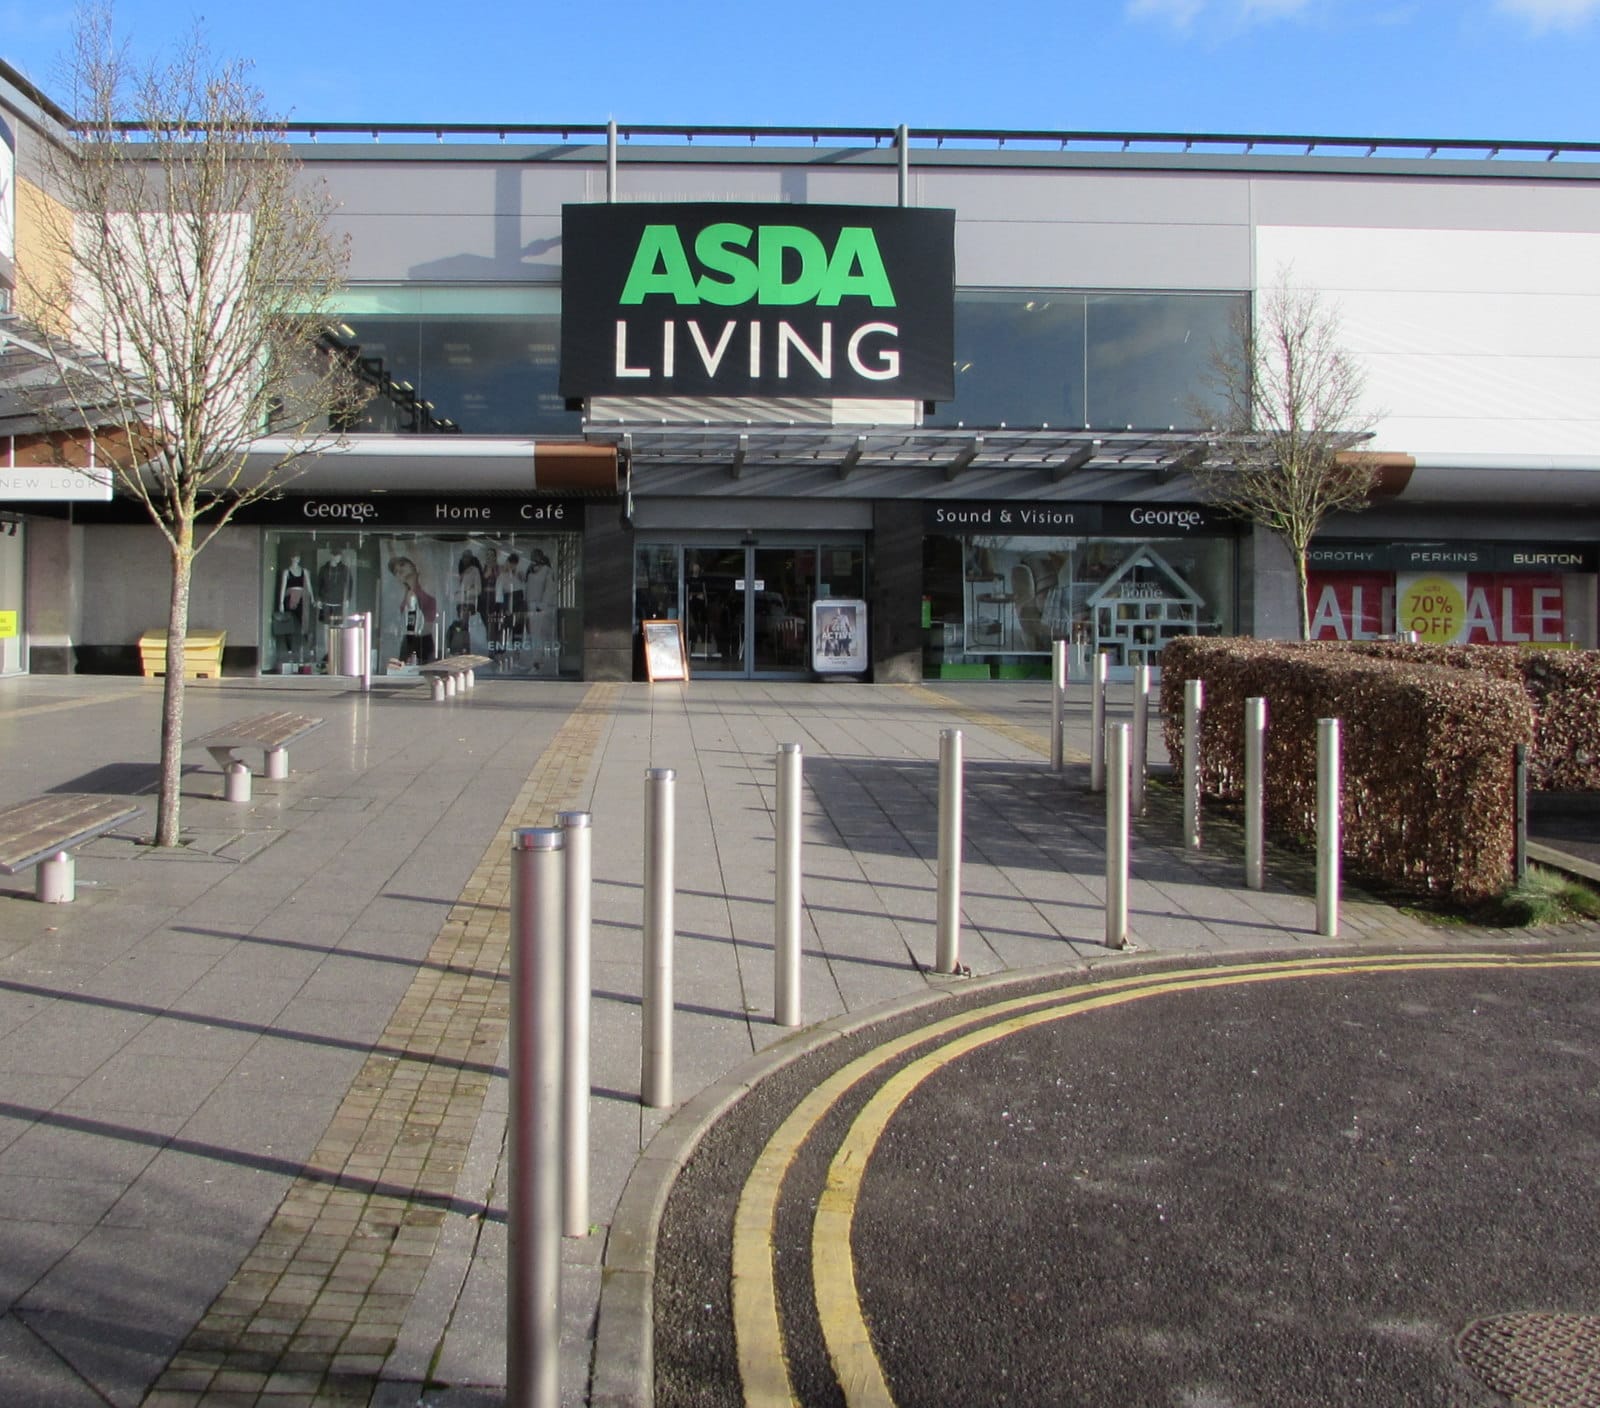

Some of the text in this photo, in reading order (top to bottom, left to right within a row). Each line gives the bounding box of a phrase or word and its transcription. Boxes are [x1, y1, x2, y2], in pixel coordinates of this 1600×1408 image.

[618, 222, 897, 307] ASDA
[614, 319, 901, 381] LIVING
[0, 478, 98, 489] NEW LOOK
[303, 500, 379, 523] George.
[435, 503, 564, 519] Home Café
[936, 508, 1074, 524] Sound & Vision
[1130, 507, 1205, 531] George.
[1410, 552, 1479, 562] PERKINS
[1513, 553, 1583, 565] BURTON
[1411, 595, 1453, 614] 70%
[1411, 616, 1452, 635] OFF
